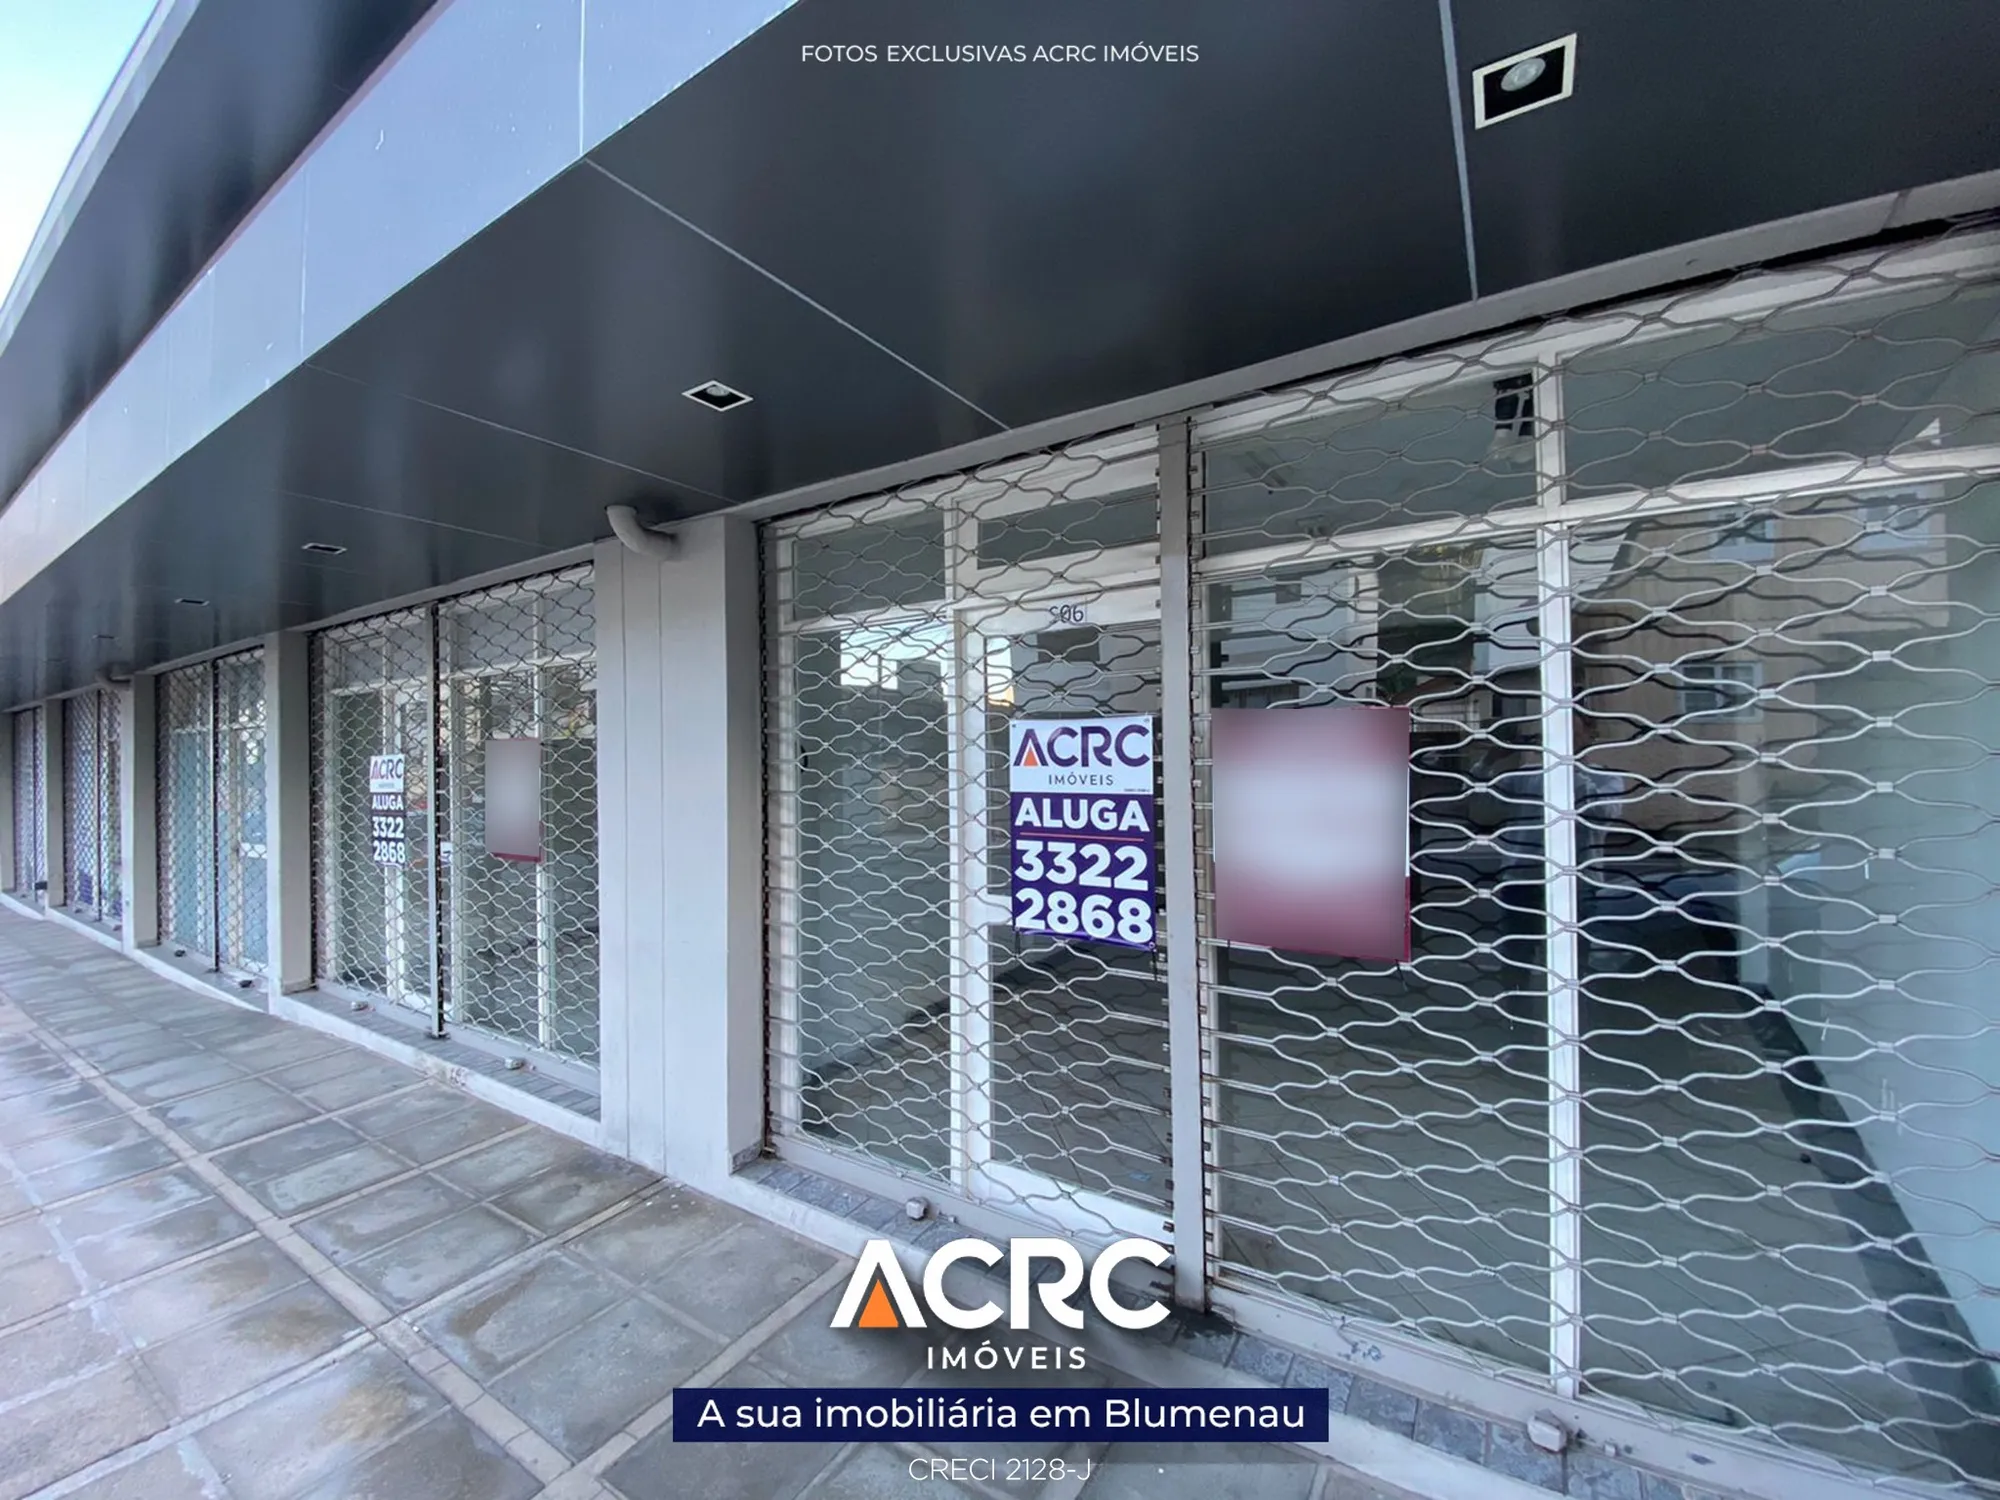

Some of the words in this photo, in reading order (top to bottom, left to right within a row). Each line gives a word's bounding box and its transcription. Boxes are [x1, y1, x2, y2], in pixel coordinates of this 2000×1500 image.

[1012, 724, 1151, 768] ACRC
[370, 759, 404, 780] ACRC
[1048, 771, 1114, 786] IMÓVEIS
[371, 794, 404, 811] ALUGA
[1014, 797, 1151, 833] ALUGA
[372, 816, 405, 839] 3322
[373, 840, 406, 864] 2868
[1014, 839, 1149, 892] 3322
[1014, 887, 1153, 944] 2868
